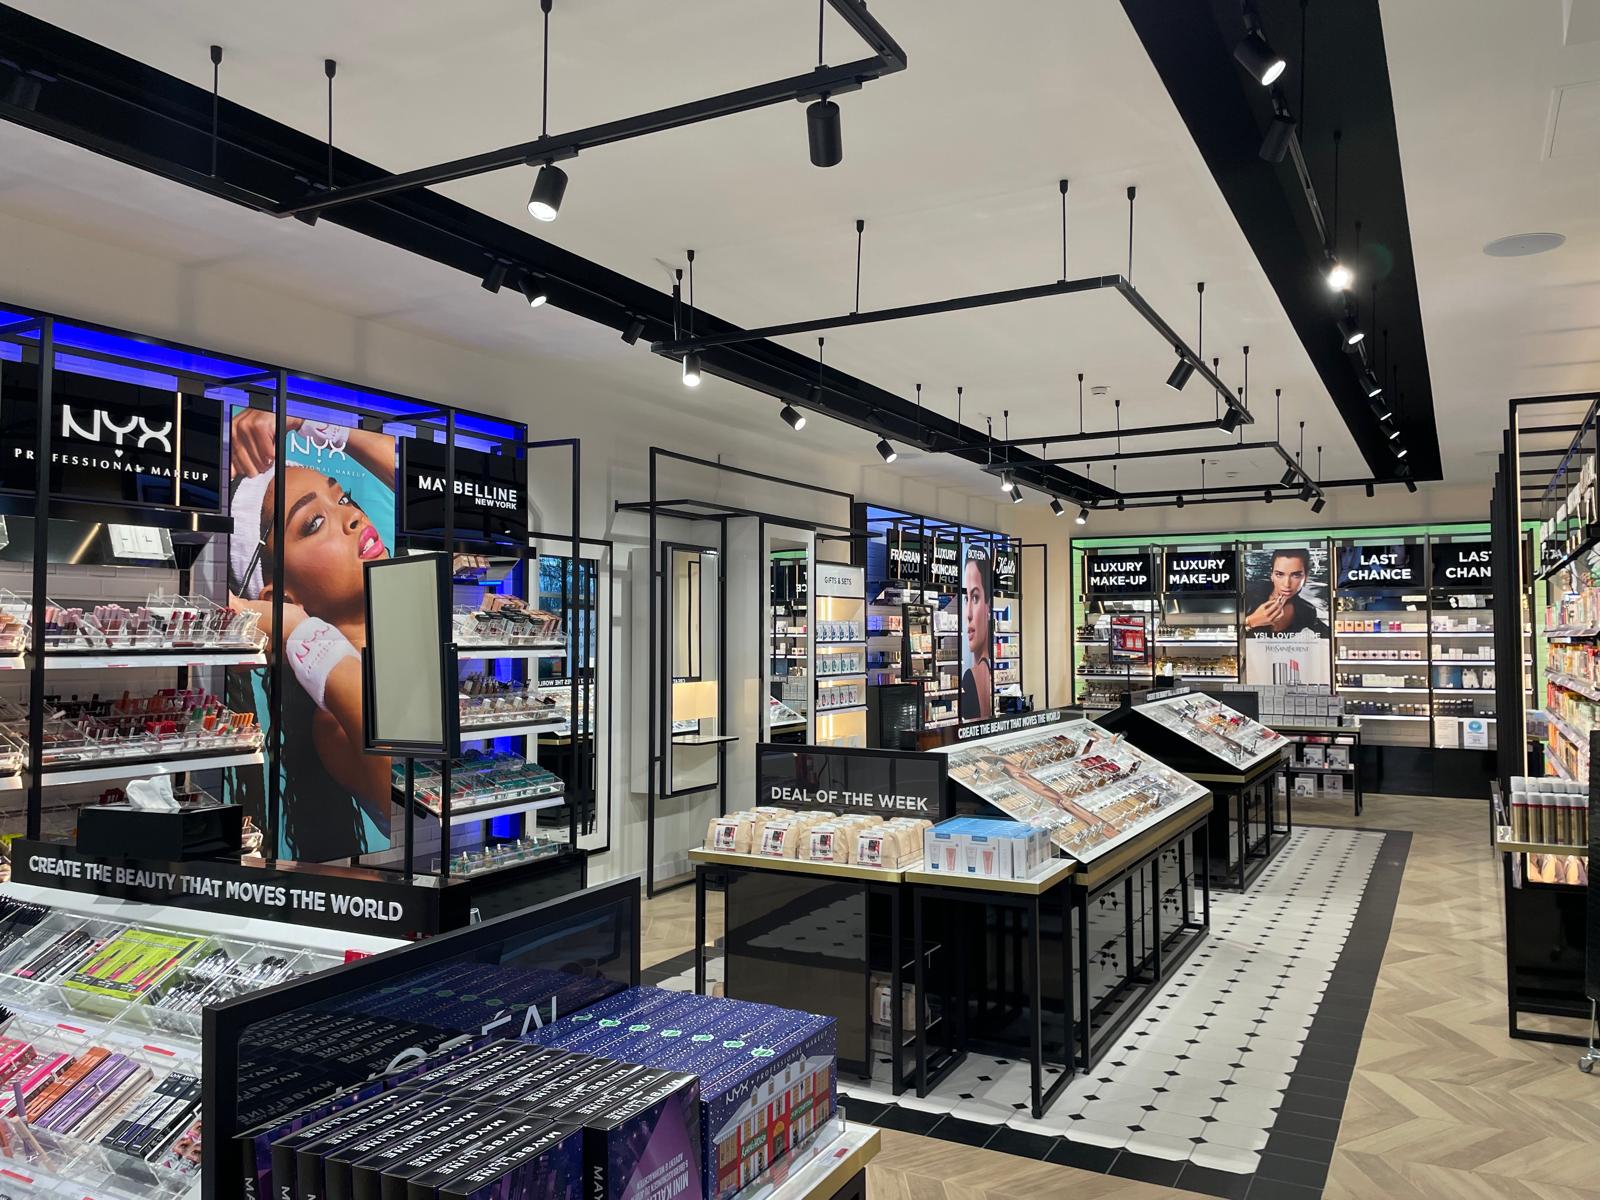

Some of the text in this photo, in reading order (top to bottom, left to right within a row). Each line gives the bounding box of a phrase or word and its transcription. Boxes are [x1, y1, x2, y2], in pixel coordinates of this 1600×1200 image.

[62, 404, 172, 452] NYX
[290, 432, 346, 461] NYX
[14, 448, 144, 473] PRFESSIONAL
[418, 475, 517, 502] MABELLINE
[475, 498, 517, 510] NEW YORK
[890, 548, 927, 564] FRAGRANE
[935, 547, 957, 561] LUXURY
[1360, 554, 1398, 566] LAST
[931, 564, 958, 577] SKINCARE
[1094, 562, 1143, 573] LUXURY
[1173, 560, 1226, 571] LUXURY
[1347, 568, 1412, 581] CHANCE
[1445, 566, 1492, 579] CHAN
[1090, 575, 1147, 586] MAKE-UP
[1169, 573, 1230, 584] MAKE-UP
[1254, 632, 1270, 640] YSL
[957, 711, 1061, 739] CREATE THE BEAUTY THAT MOVES THE WORLD
[771, 786, 929, 811] DEAL OF THE WEEK
[29, 855, 403, 922] CREATE THE BEAUTY THAT MOVES THE WORLD
[725, 1080, 749, 1105] NYX
[756, 1047, 802, 1085] PROFESSIONAL
[581, 1074, 655, 1114] MAYBELLINE
[410, 1119, 506, 1167] MAYBELLINE
[440, 1125, 532, 1175] MAYBELLINE
[471, 1131, 561, 1182] MAYBELLINE
